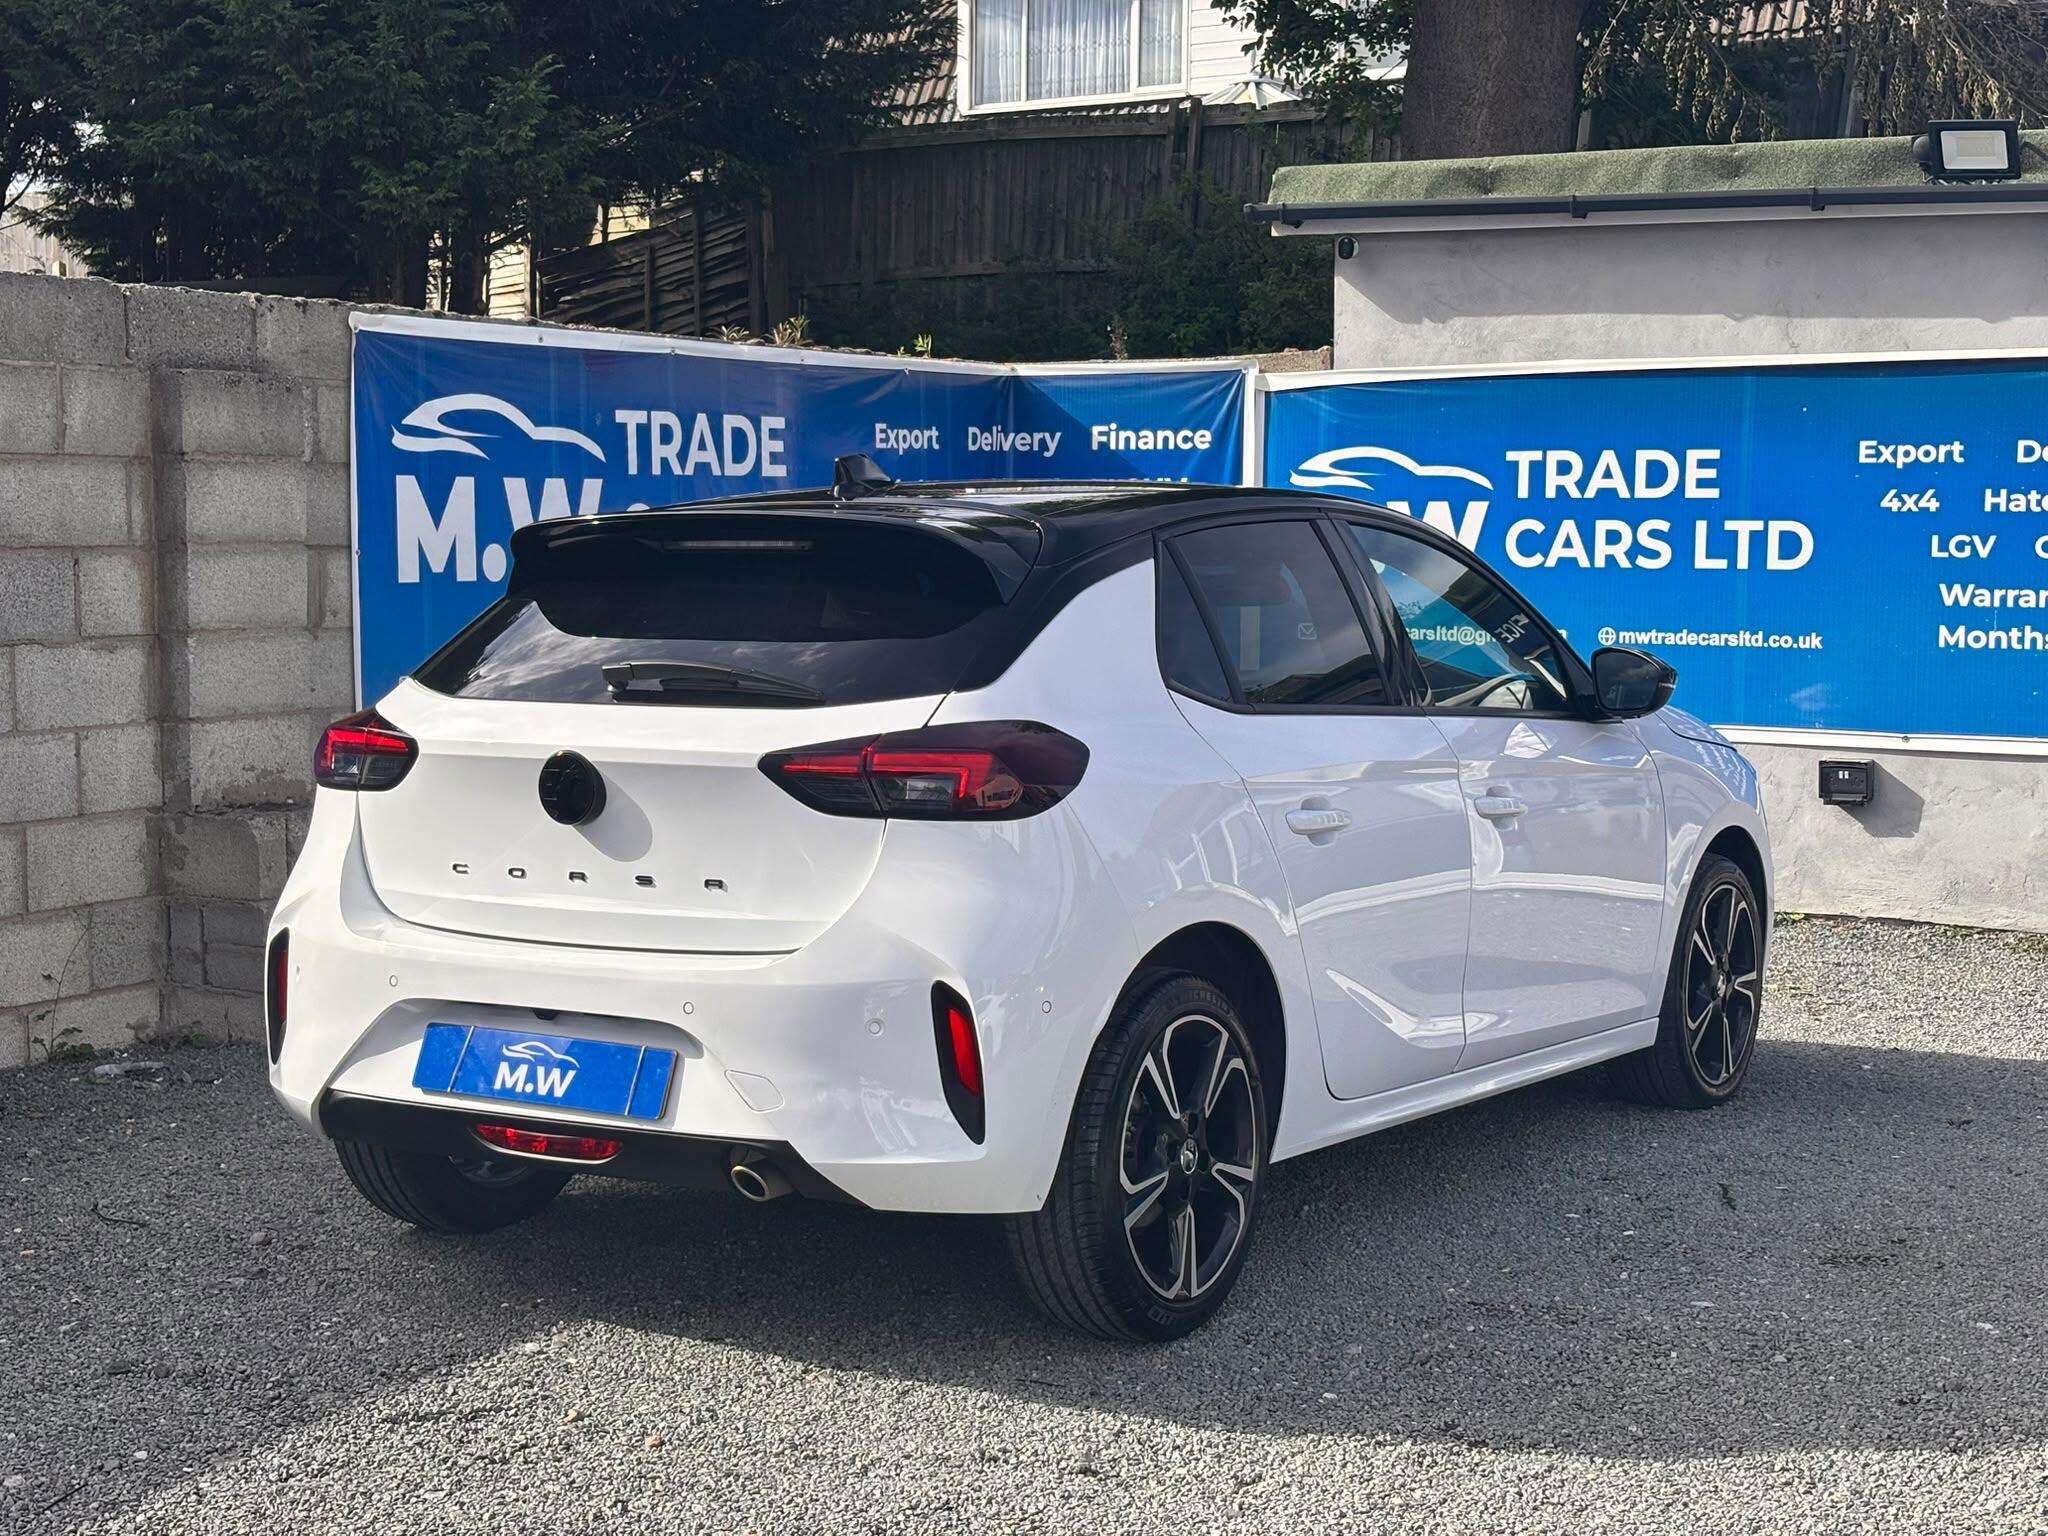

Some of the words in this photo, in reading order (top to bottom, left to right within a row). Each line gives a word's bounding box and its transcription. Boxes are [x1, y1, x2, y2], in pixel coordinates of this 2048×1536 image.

[615, 410, 787, 477] TRADE
[873, 423, 939, 456] Export
[967, 424, 1062, 458] Delivery
[1091, 423, 1212, 450] Finance
[1858, 440, 1965, 469] Export
[1505, 449, 1721, 499] TRADE
[1880, 488, 1940, 512] 4x4
[1505, 518, 1673, 570] CARS
[1694, 519, 1814, 571] LTD
[1931, 534, 1997, 559] LGV
[1618, 628, 1823, 649] mwtradecarsltd.co.uk
[1938, 624, 2048, 650] Month
[452, 863, 728, 893] CORSA
[493, 1061, 578, 1099] M.W
